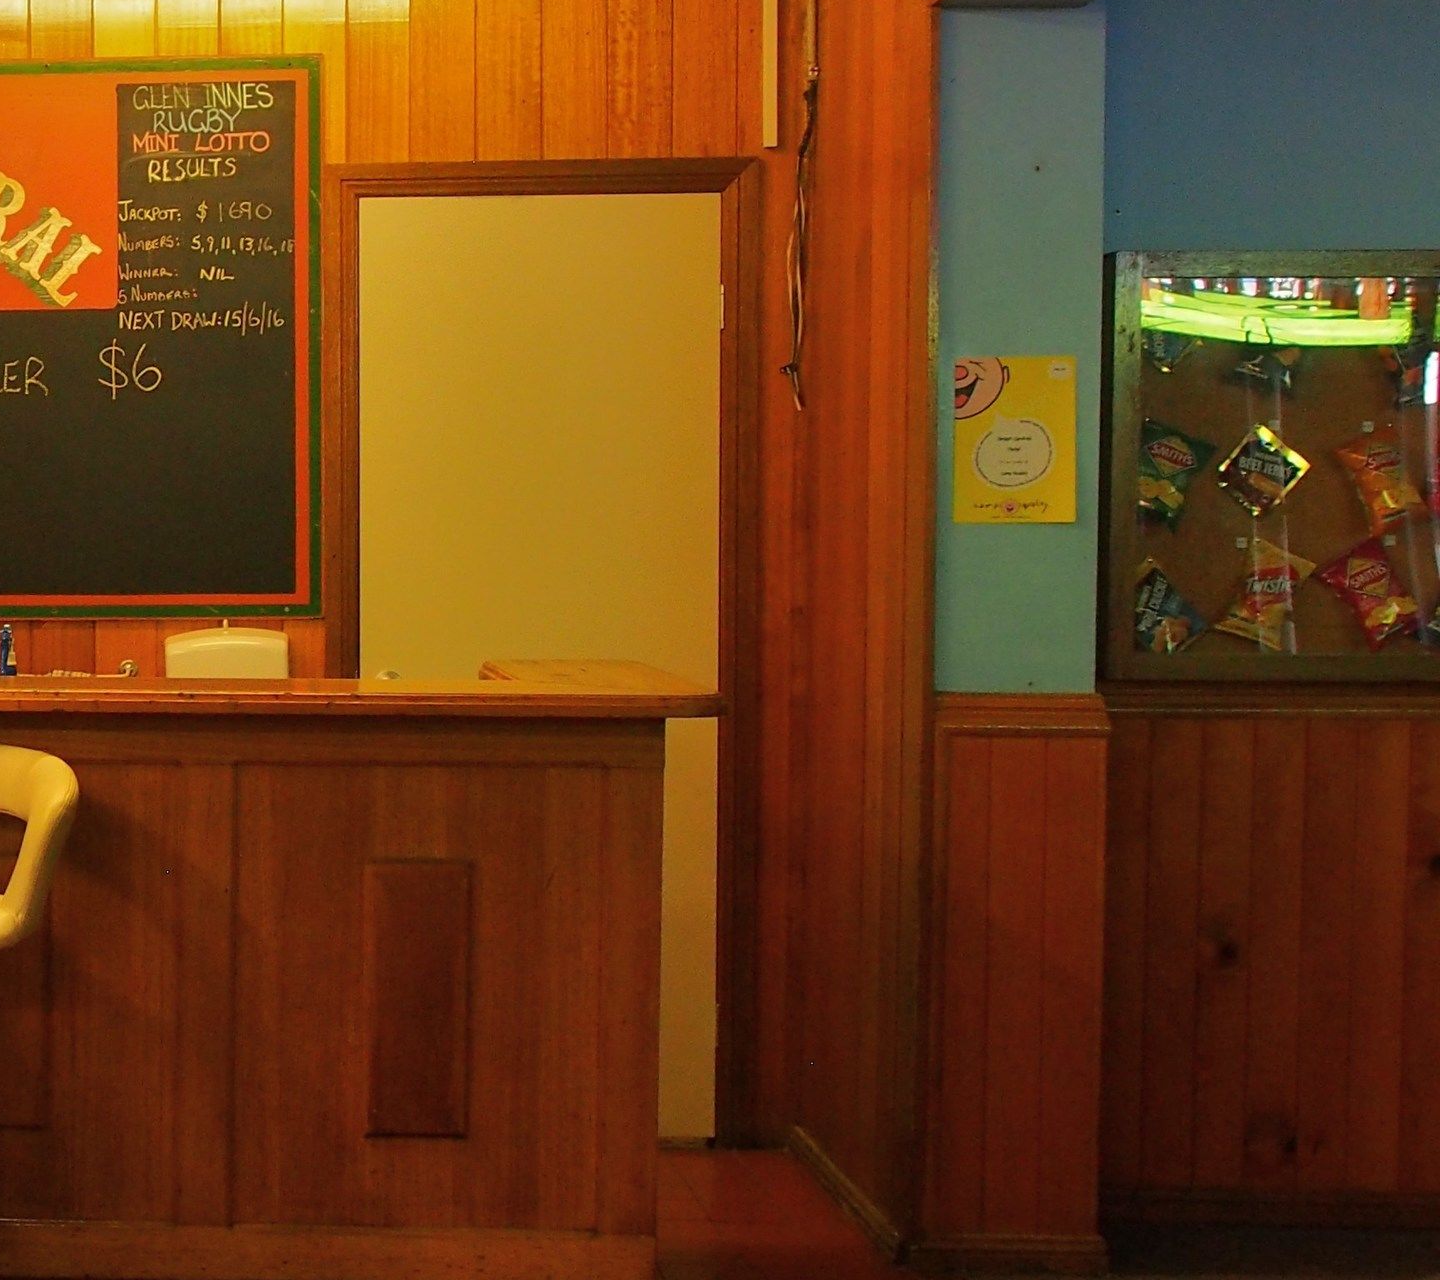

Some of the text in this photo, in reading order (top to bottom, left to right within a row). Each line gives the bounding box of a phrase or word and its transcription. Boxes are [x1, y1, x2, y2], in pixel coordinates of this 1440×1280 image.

[132, 82, 274, 111] GLEN INNES
[153, 107, 240, 134] RUGBY
[132, 131, 271, 154] MINI LOTTO
[147, 157, 237, 183] RESULTS
[200, 266, 235, 281] NIL
[119, 310, 165, 331] NEXT
[97, 337, 162, 400] $6
